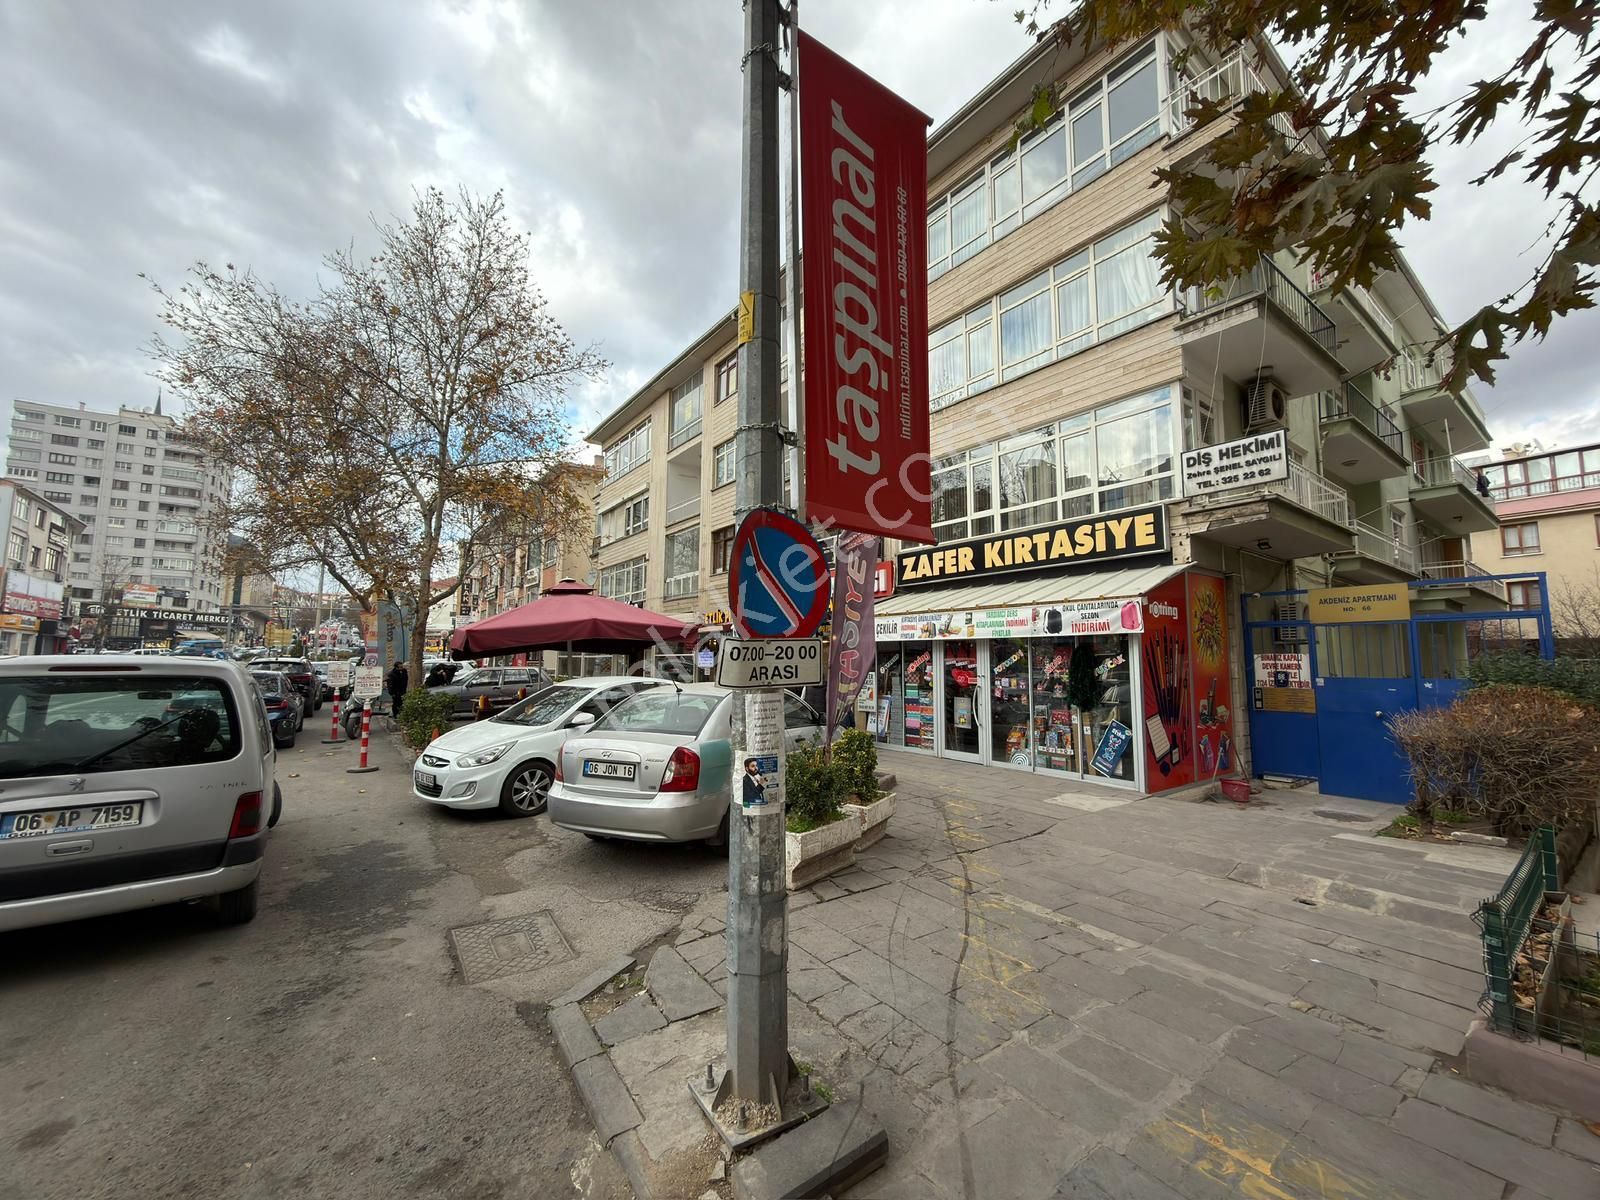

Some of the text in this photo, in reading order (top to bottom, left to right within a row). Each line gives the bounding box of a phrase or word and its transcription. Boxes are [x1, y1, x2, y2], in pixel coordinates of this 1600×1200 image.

[825, 98, 894, 476] taşpınar
[898, 304, 912, 441] indirim.taspinar.com
[1186, 433, 1281, 467] DİŞ HEKİMİ
[1221, 475, 1239, 485] 325
[1243, 471, 1256, 480] 22
[1257, 468, 1271, 477] 62
[901, 546, 975, 581] ZAFER
[1319, 594, 1397, 605] AKDENİZ APARTMANI
[116, 608, 148, 618] ETLİK
[152, 609, 193, 621] TİCARET
[1080, 612, 1100, 620] SEZON
[876, 620, 898, 639] ÇEKİLİR
[1071, 618, 1111, 633] İNDİRİMİ
[749, 665, 799, 681] ARASI
[588, 764, 633, 776] 06 JON 16
[15, 813, 42, 832] 06
[55, 809, 81, 828] AP
[89, 805, 135, 825] 7159
